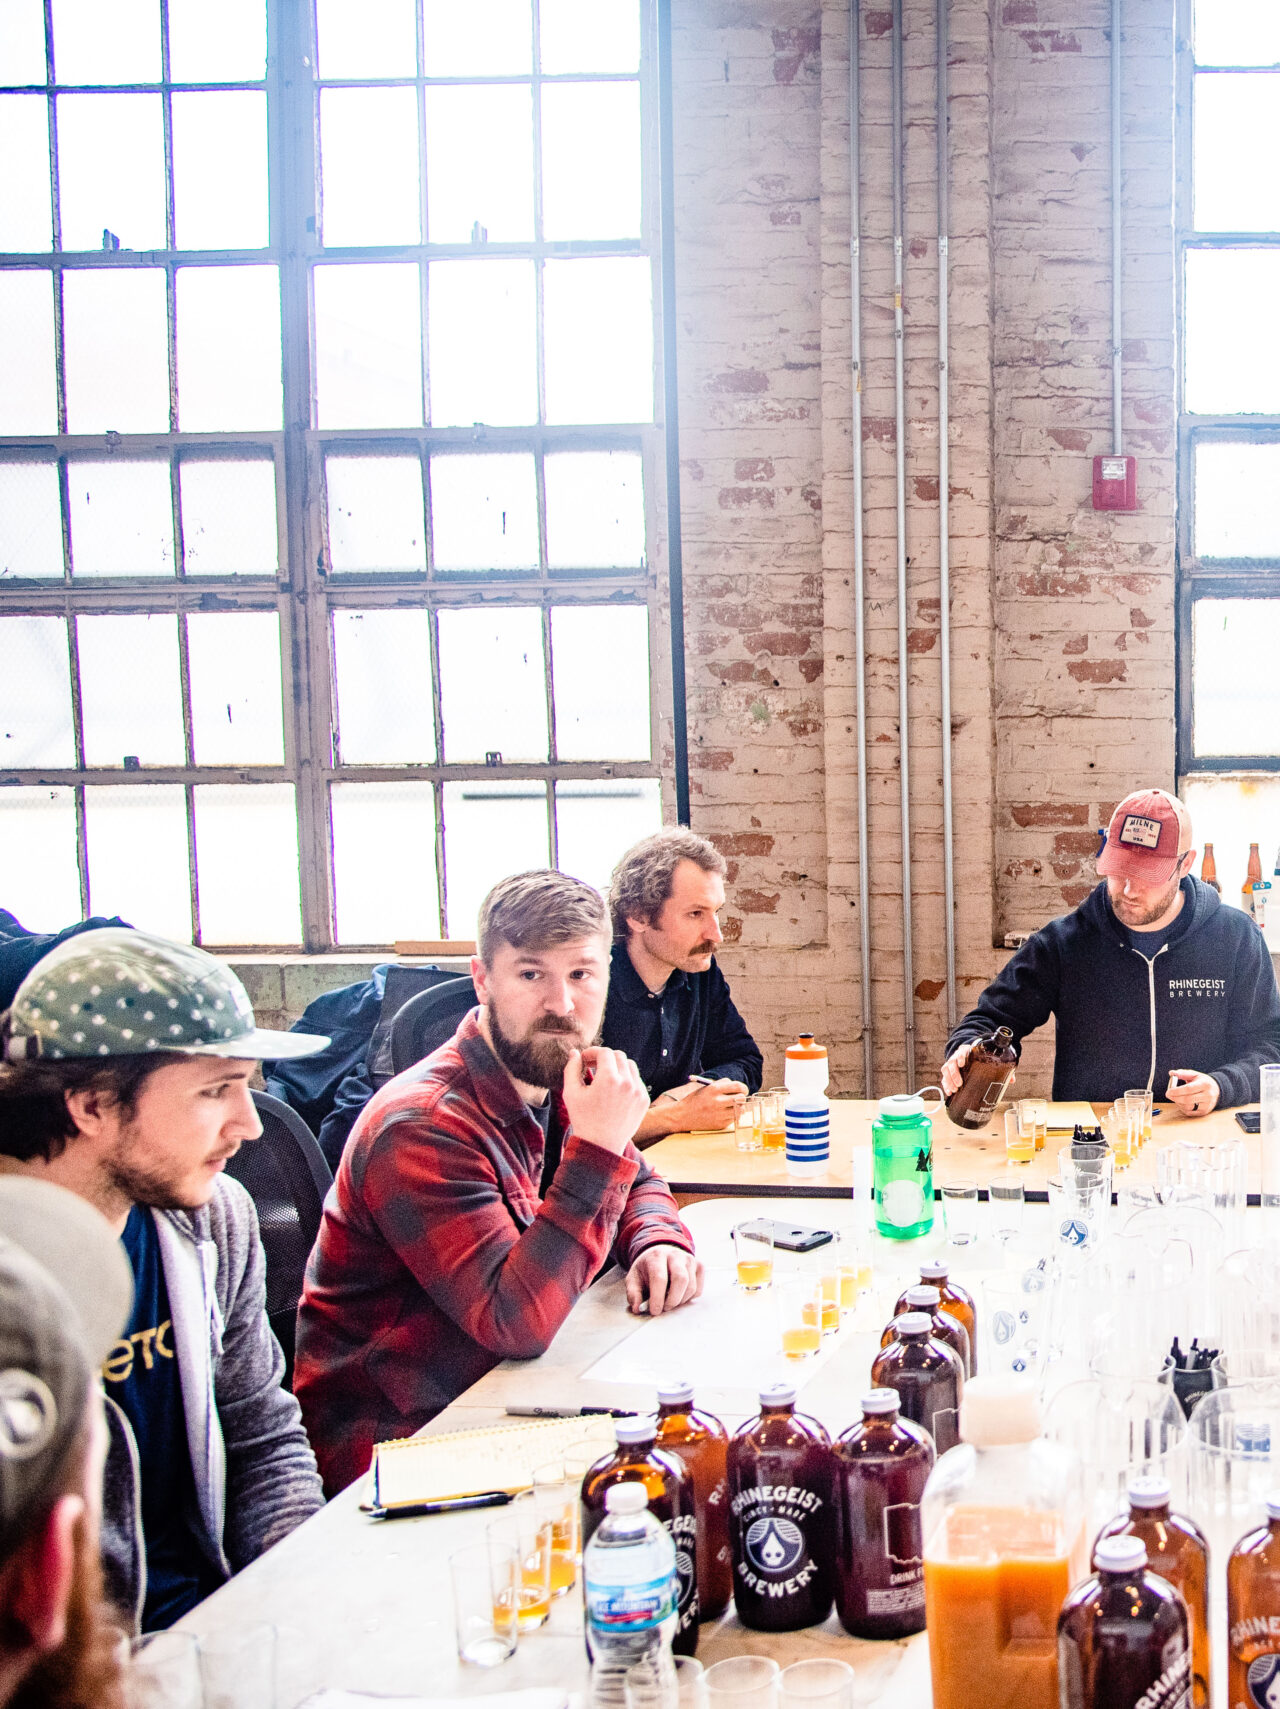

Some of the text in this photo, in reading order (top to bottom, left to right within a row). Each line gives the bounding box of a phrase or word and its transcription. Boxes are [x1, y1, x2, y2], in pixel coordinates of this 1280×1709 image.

[1130, 819, 1154, 831] MILNE
[1169, 979, 1226, 989] RHINEGEIST
[1169, 990, 1226, 998] BREWERY
[730, 1485, 823, 1516] RHINEGEIST
[737, 1559, 819, 1598] BREWERY
